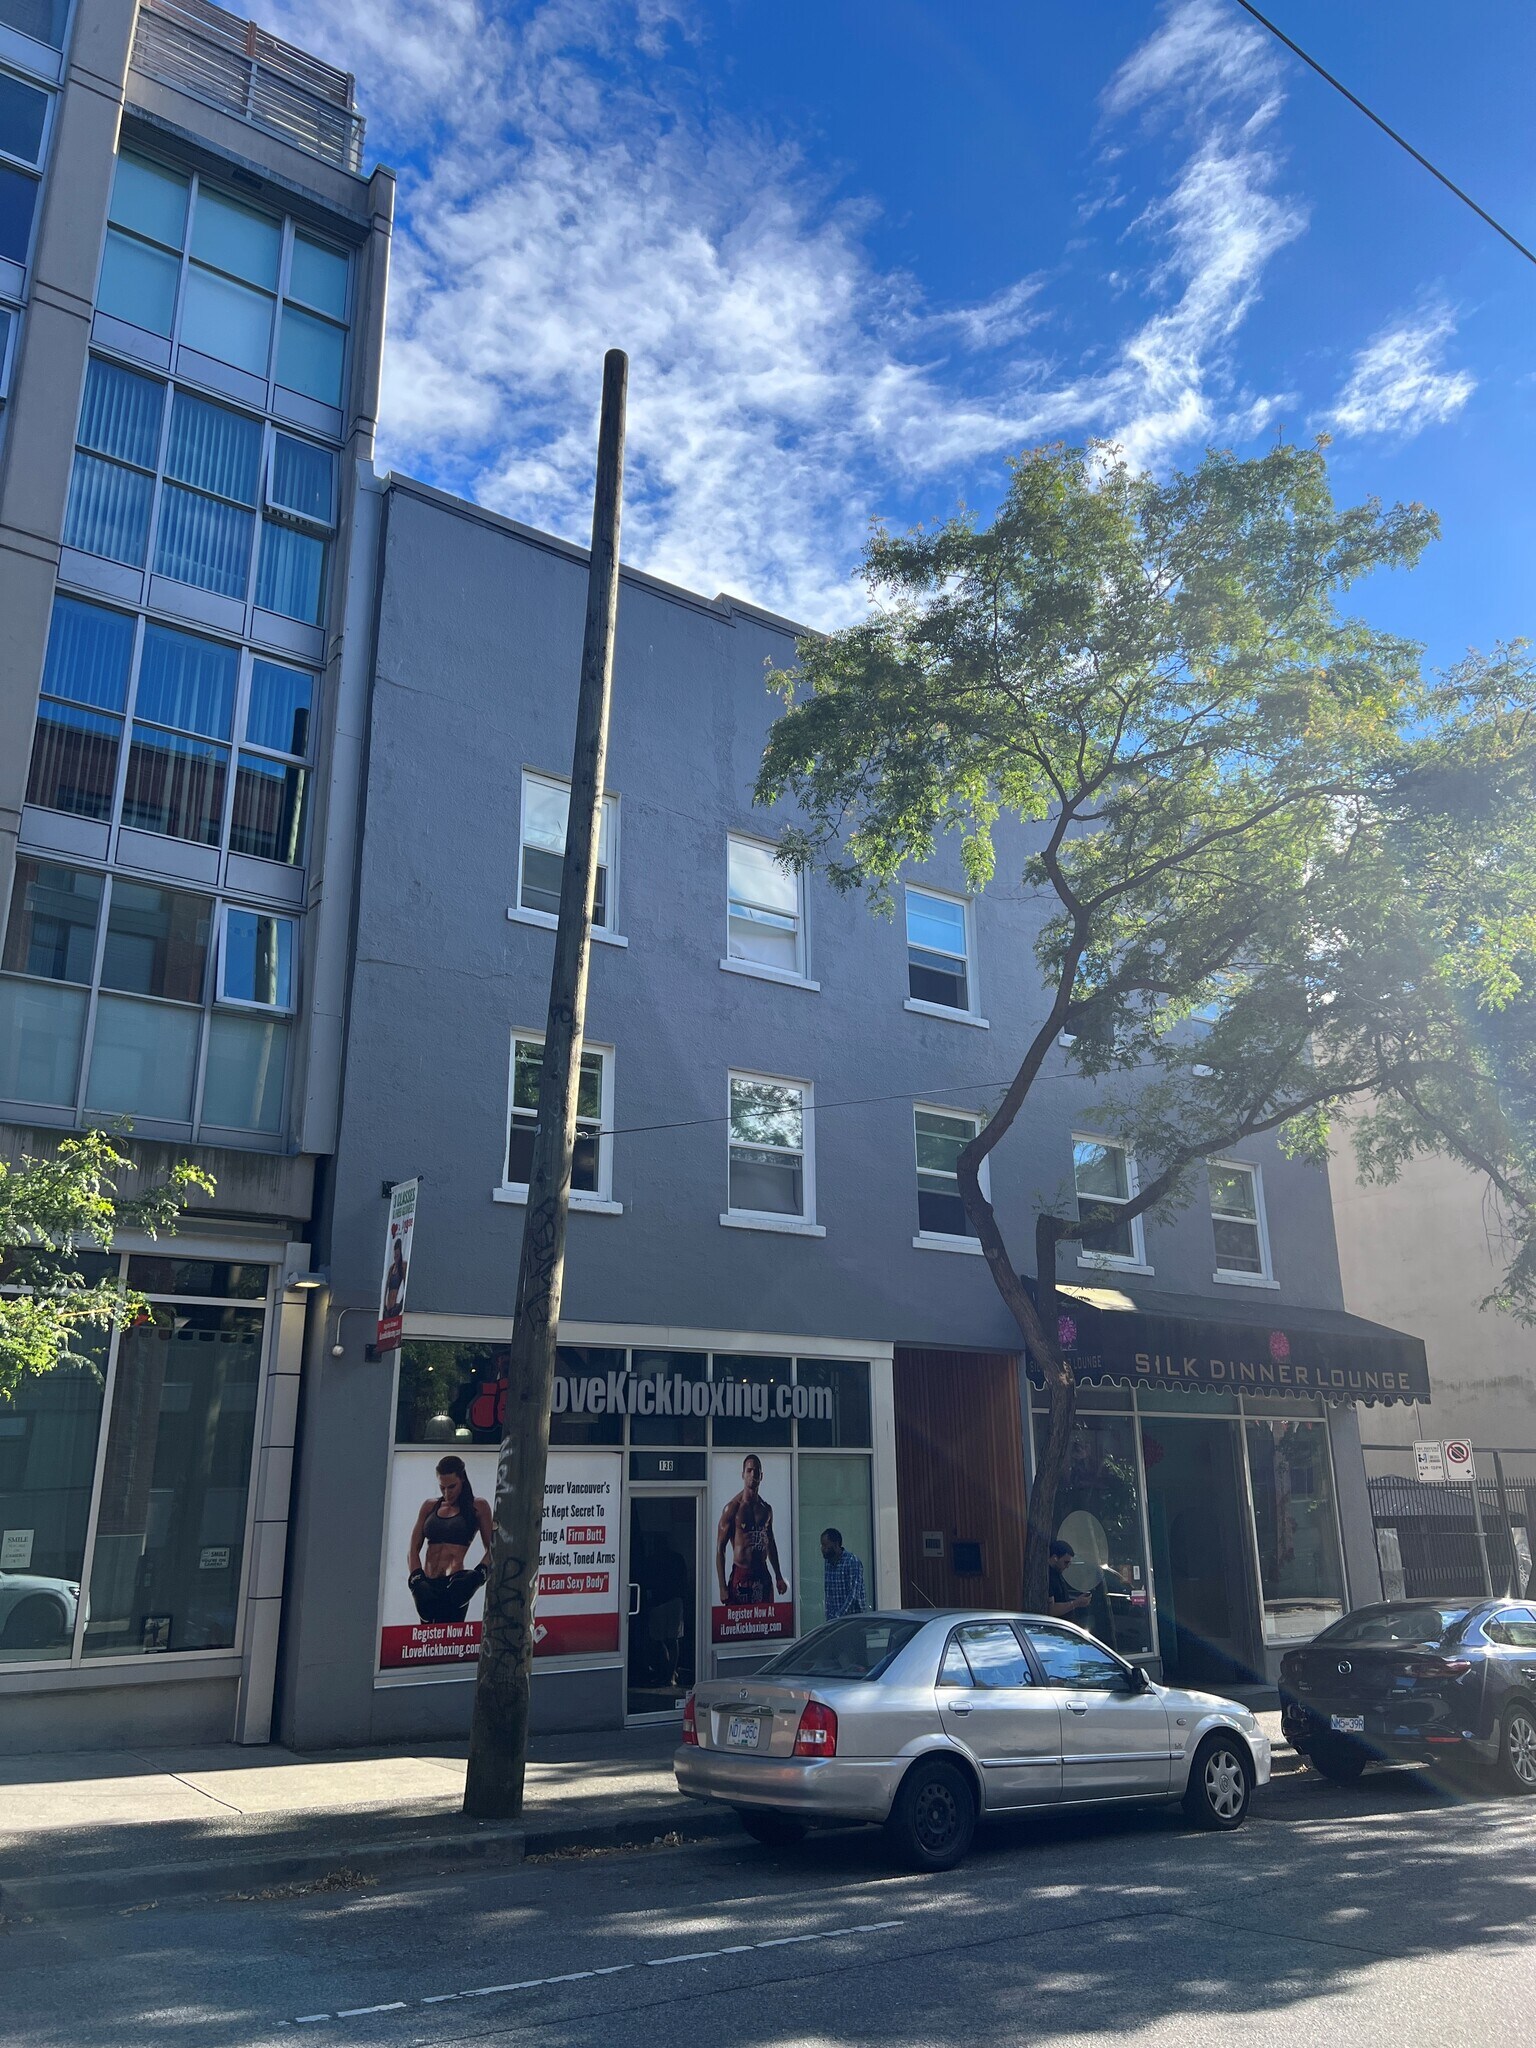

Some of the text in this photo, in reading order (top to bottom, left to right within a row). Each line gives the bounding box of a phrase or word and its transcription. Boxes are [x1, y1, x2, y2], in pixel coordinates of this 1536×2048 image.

[1073, 1355, 1102, 1370] LOUNGE
[1135, 1353, 1411, 1390] SILK DINNER LOUNGE
[551, 1371, 833, 1423] oveKickboxing.com
[660, 1461, 673, 1470] 136
[566, 1481, 610, 1494] Vancouver's
[551, 1505, 569, 1520] Kept
[571, 1504, 594, 1517] Secret
[596, 1504, 605, 1517] To
[560, 1528, 565, 1541] A
[568, 1528, 585, 1542] Firm
[586, 1528, 605, 1542] Butt,
[548, 1552, 571, 1567] Waist,
[573, 1551, 595, 1565] Toned
[596, 1551, 616, 1564] Arms
[540, 1577, 546, 1590] A
[547, 1576, 565, 1590] Lean
[566, 1575, 584, 1591] Sexy
[727, 1605, 775, 1622] Register Now At
[412, 1624, 474, 1642] Register Now At
[720, 1621, 782, 1635] iLoveKickboxing.com
